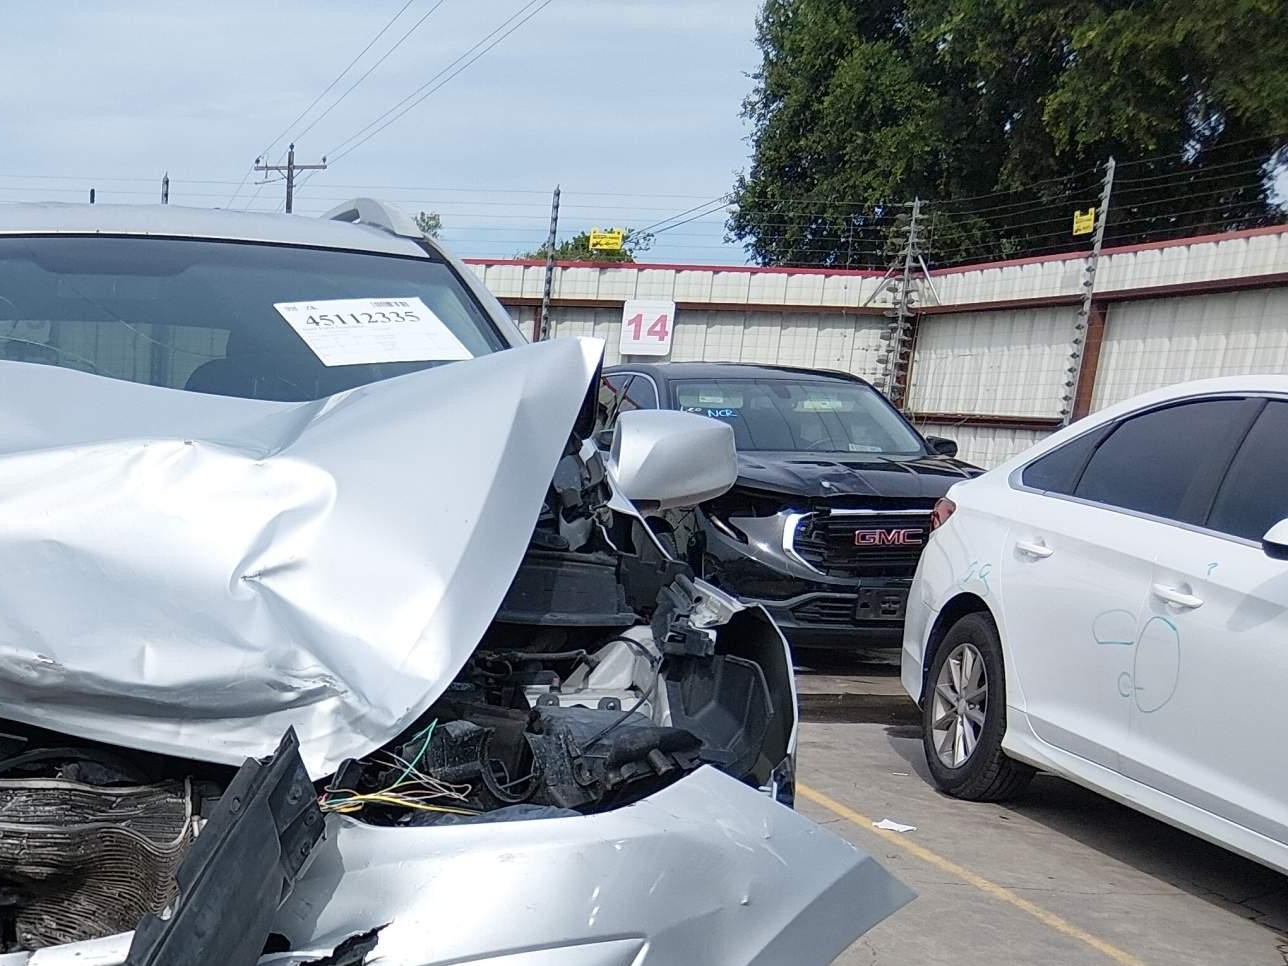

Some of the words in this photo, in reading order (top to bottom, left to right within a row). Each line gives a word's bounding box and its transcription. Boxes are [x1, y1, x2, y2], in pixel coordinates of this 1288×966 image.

[305, 311, 421, 327] 45112335
[627, 313, 669, 342] 14
[855, 528, 924, 546] GMC
